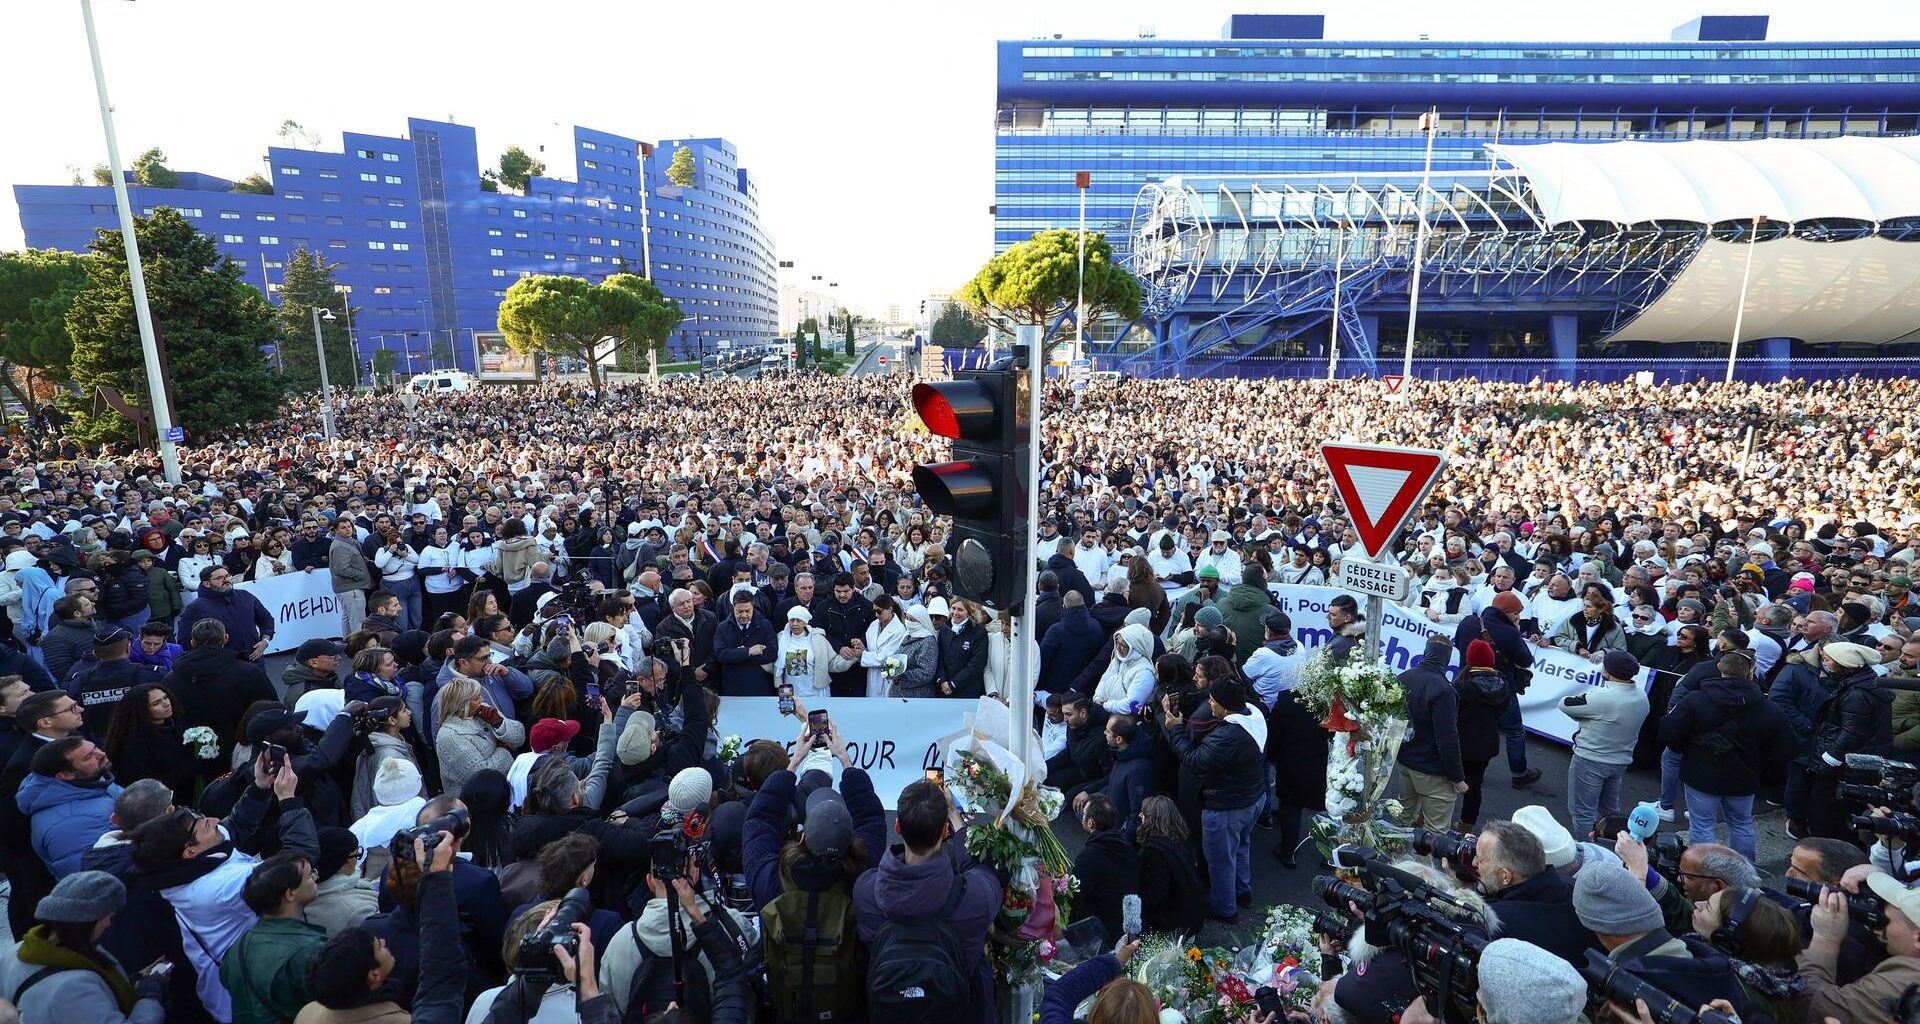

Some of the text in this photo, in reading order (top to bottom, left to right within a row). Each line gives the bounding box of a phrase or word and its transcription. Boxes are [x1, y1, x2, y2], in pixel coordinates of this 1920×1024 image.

[1347, 564, 1396, 583] CÉDEZ LE
[1346, 576, 1395, 595] PASSAGE
[280, 596, 339, 624] MEHDI
[1298, 598, 1331, 613] Pou
[1533, 658, 1606, 688] Marseill
[845, 740, 896, 770] OUR
